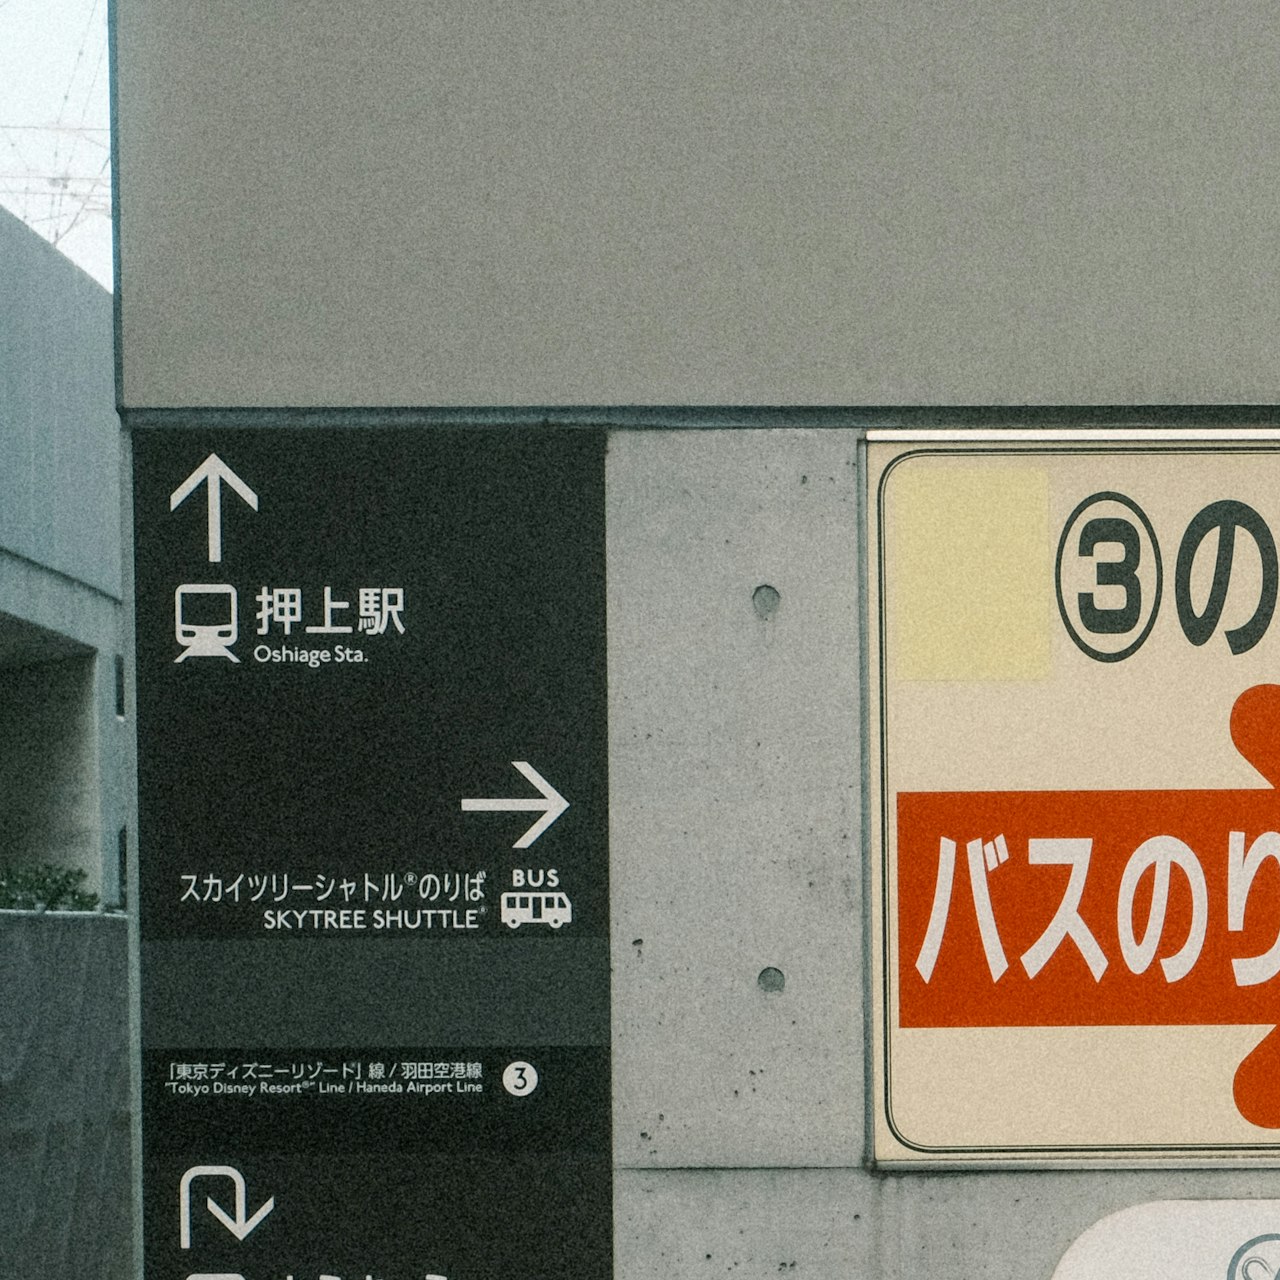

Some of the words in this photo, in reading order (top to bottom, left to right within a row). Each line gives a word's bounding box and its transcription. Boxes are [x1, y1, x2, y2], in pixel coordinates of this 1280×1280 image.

[255, 586, 406, 636] 押上駅
[253, 645, 331, 668] Oshiage
[335, 646, 369, 663] Sta.
[512, 869, 559, 888] BUS
[263, 910, 367, 930] SKYTREE
[401, 1062, 483, 1080] 羽田空港線
[213, 1082, 256, 1098] Disney
[319, 1081, 345, 1094] Line
[356, 1081, 403, 1094] Haneda
[406, 1082, 452, 1098] Airport
[456, 1081, 483, 1094] Line
